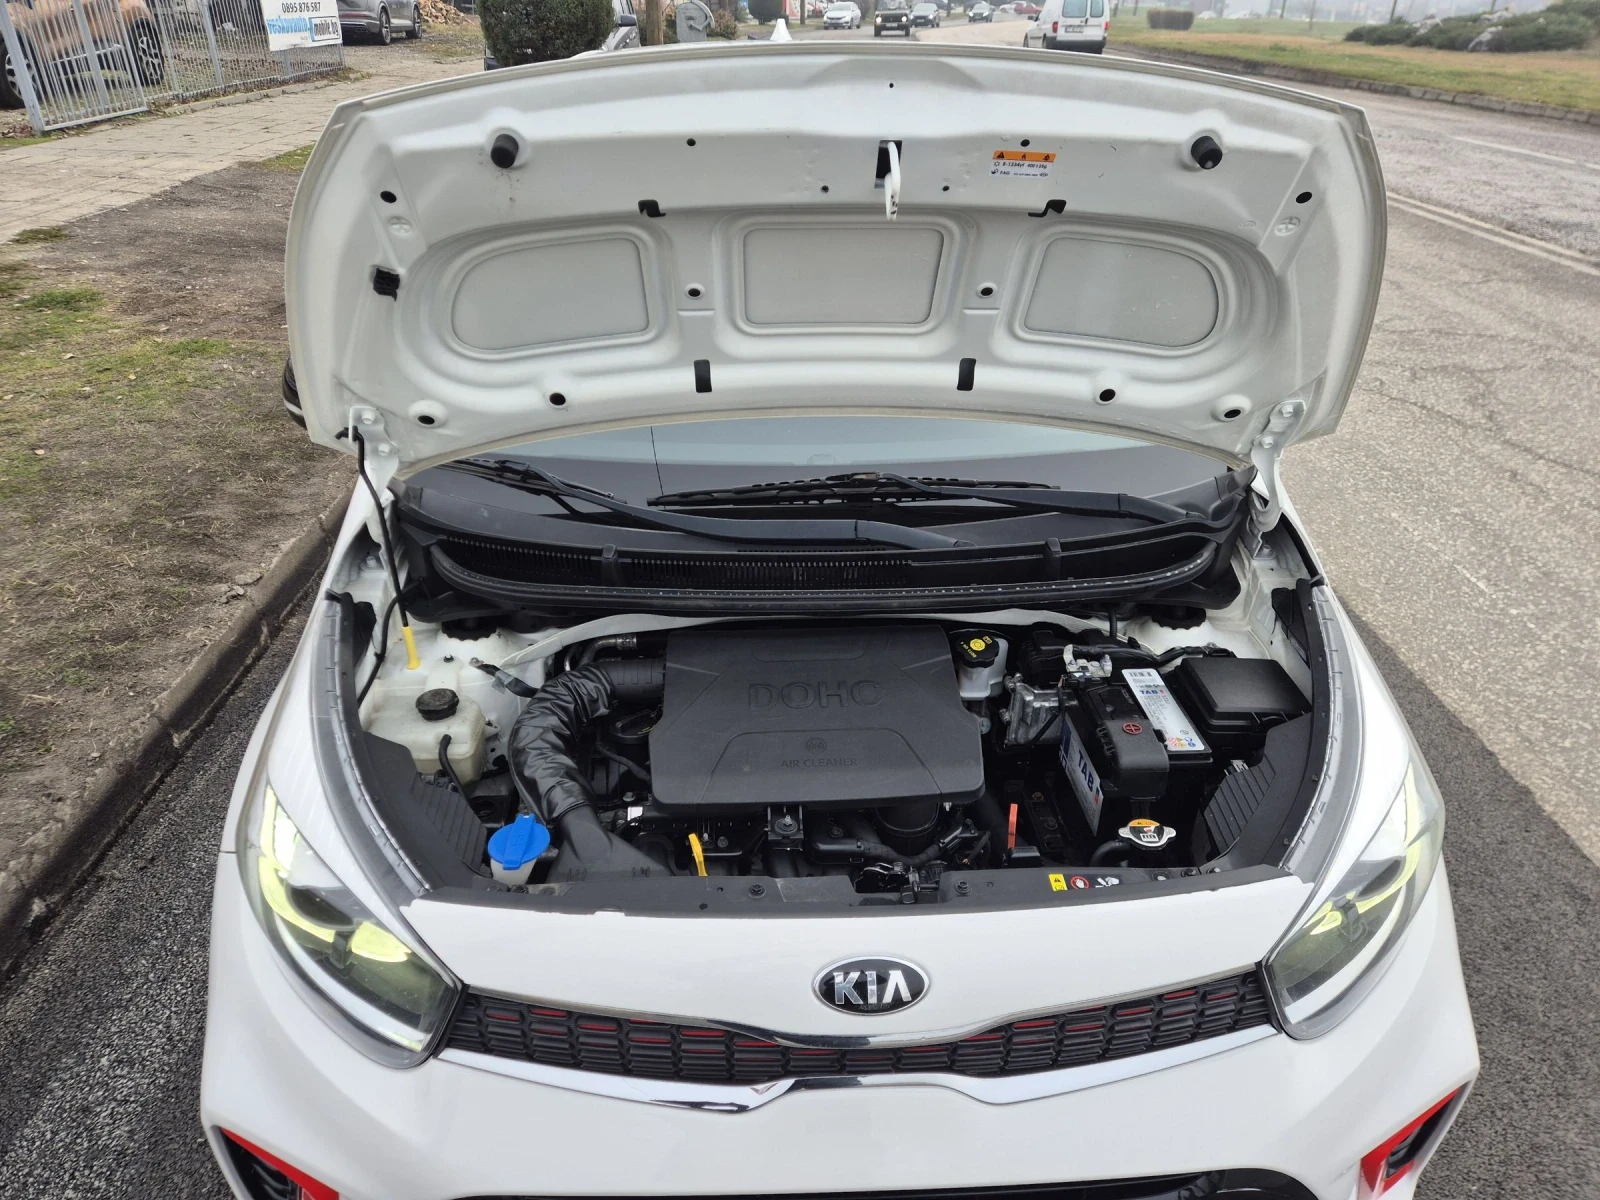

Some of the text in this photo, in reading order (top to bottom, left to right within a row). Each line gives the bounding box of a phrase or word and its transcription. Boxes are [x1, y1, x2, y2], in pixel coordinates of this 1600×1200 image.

[281, 2, 321, 13] 0895 876 587
[750, 680, 884, 709] DOHC
[781, 758, 858, 768] AIR CLEANER
[1078, 749, 1094, 792] TAB
[833, 970, 912, 1005] KIA
